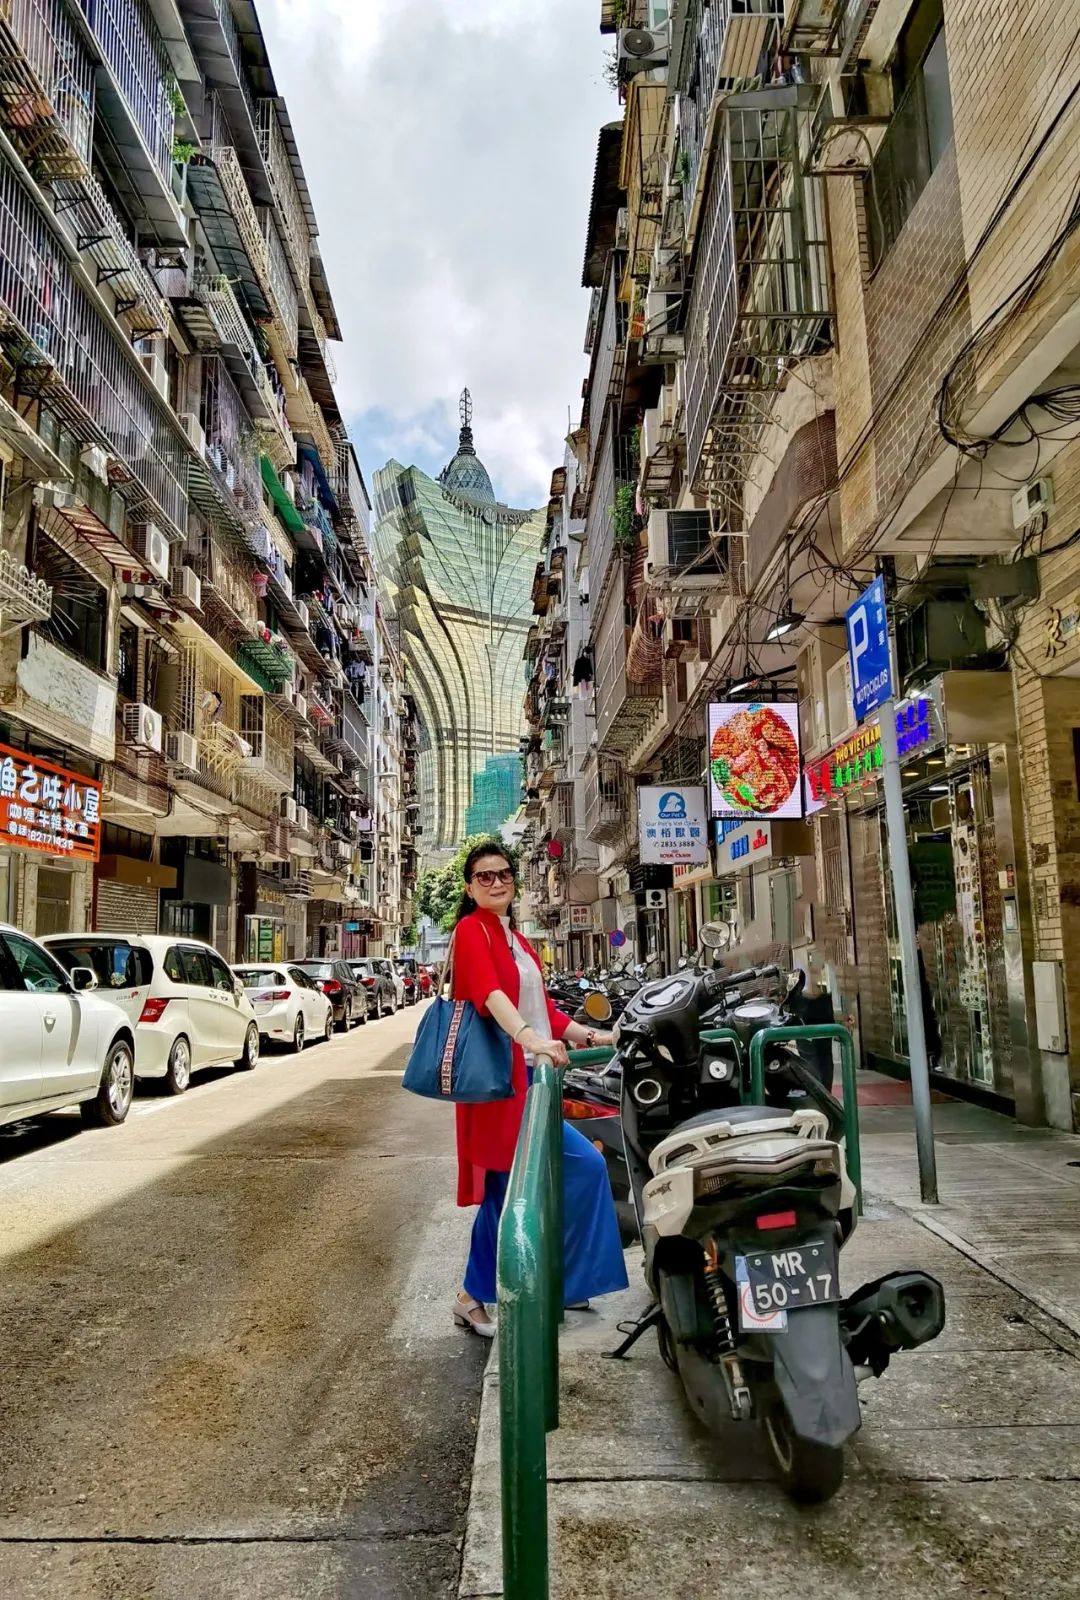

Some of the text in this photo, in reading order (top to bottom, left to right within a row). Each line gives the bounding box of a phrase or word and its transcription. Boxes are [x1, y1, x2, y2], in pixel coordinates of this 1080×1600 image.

[849, 604, 869, 689] P
[856, 668, 888, 705] MOTOCICLOS
[849, 724, 881, 756] VIETNAM
[771, 1251, 806, 1278] MR
[755, 1273, 832, 1309] 50-17
